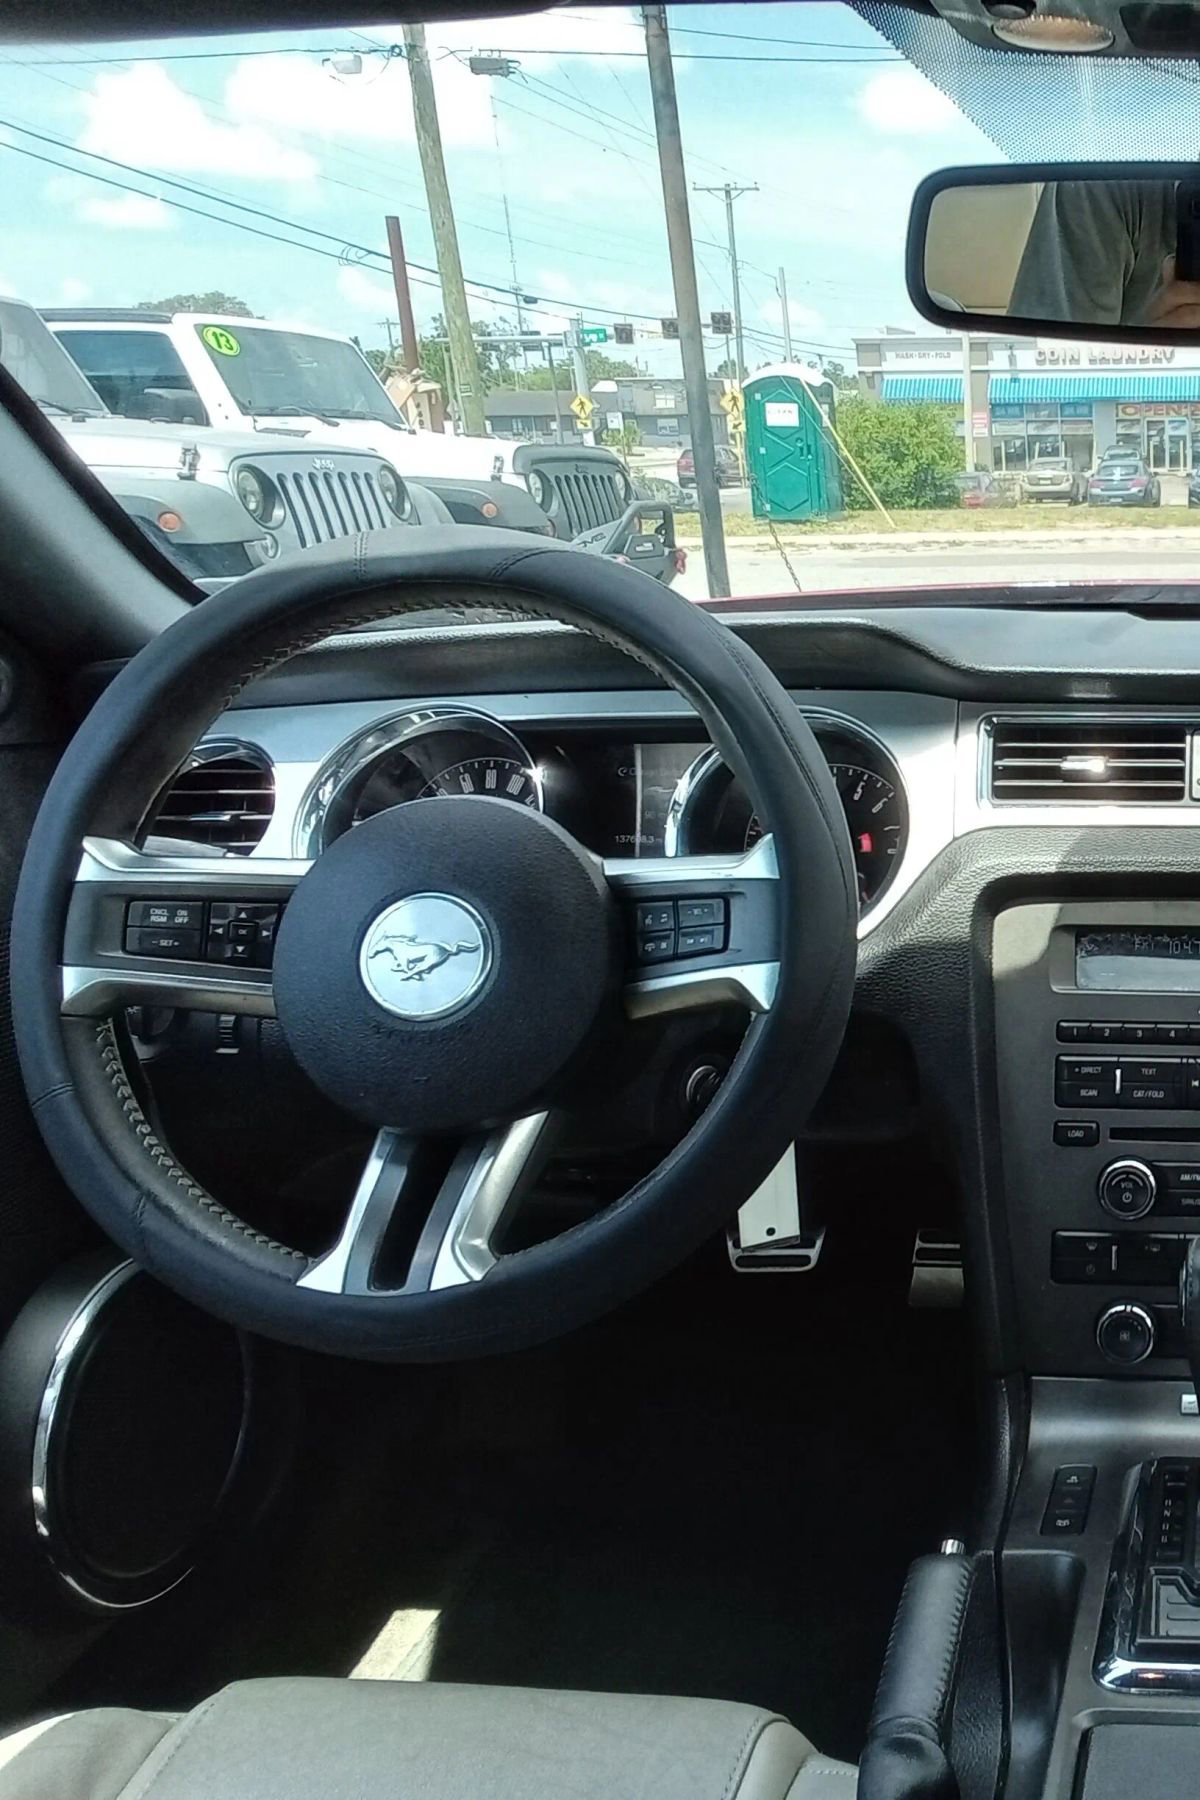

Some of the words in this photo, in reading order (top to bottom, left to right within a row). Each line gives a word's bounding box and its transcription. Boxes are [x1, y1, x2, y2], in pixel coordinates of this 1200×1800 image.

[211, 330, 234, 351] 13
[1035, 347, 1081, 366] COIN
[1088, 347, 1176, 365] LAUNDRY
[1120, 403, 1182, 417] OPEN
[458, 772, 475, 794] 60
[484, 768, 497, 790] 80
[506, 773, 526, 796] 100
[174, 916, 190, 924] OFF
[1080, 1089, 1098, 1097] SCAN
[1133, 1089, 1165, 1099] CAT/FOLD
[1067, 1129, 1085, 1138] LOAD
